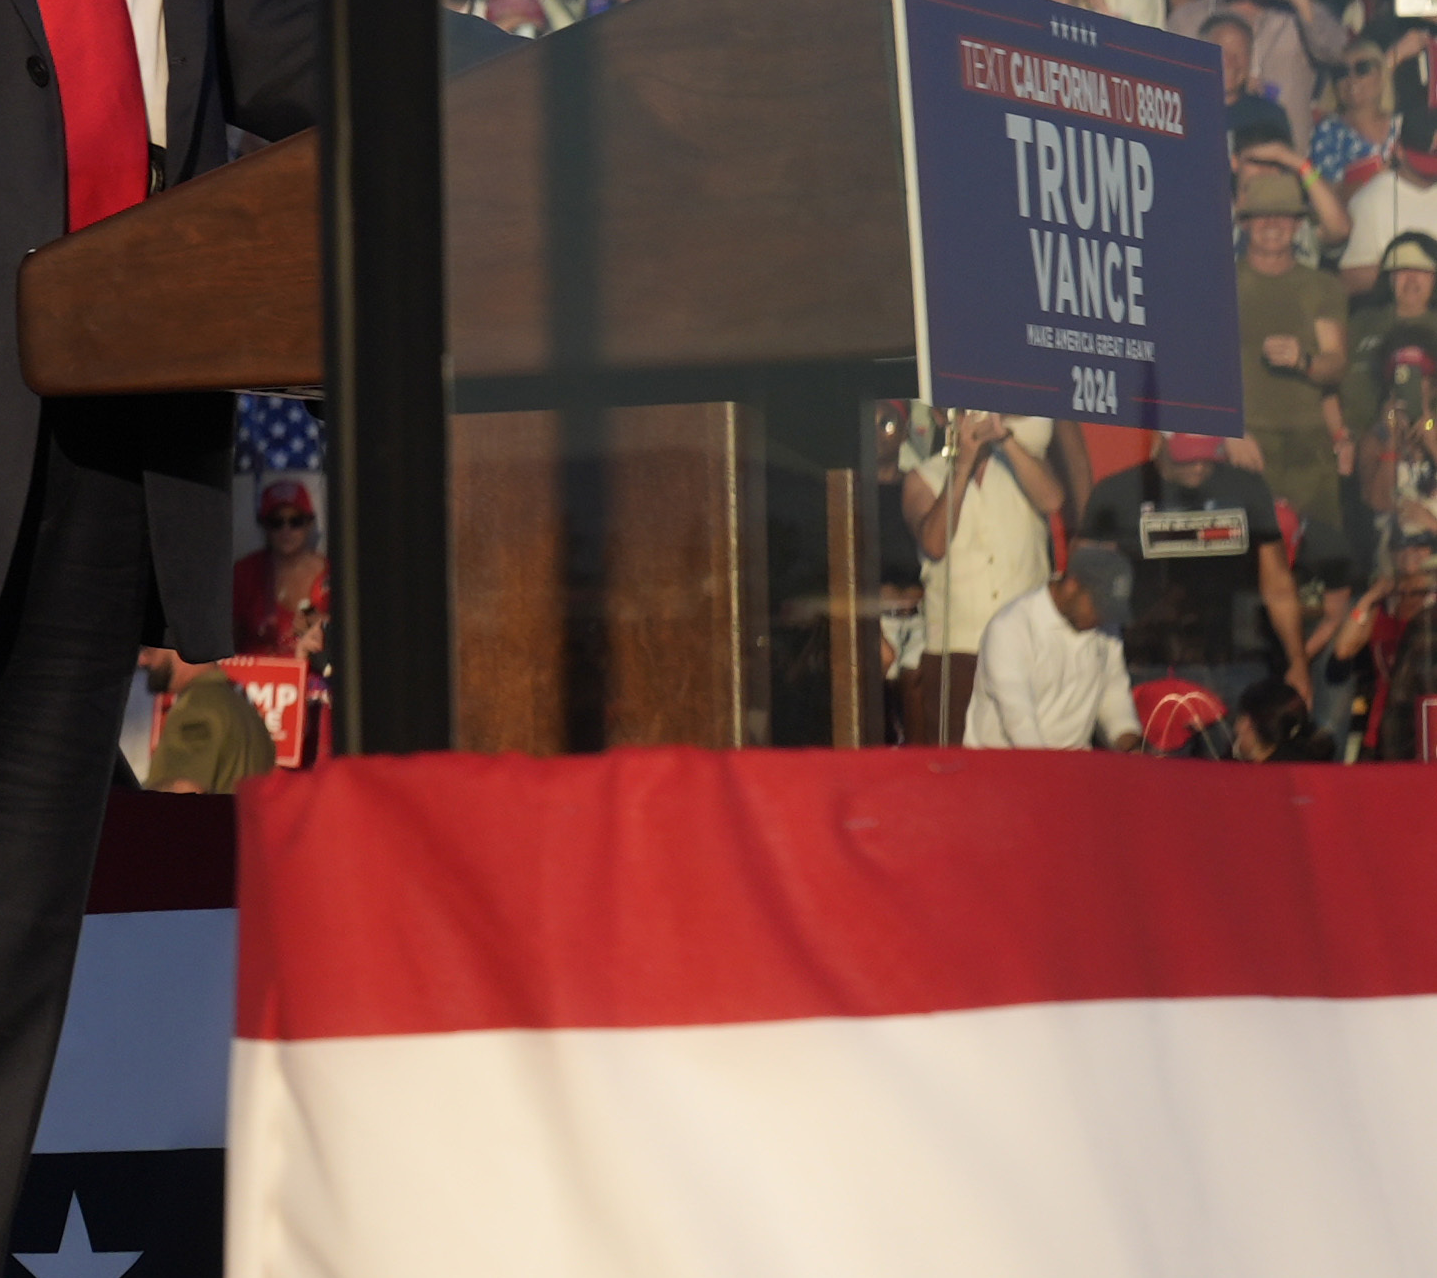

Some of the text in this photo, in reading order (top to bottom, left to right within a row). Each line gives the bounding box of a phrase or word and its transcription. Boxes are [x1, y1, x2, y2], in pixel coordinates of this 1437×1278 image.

[960, 39, 1184, 135] TEXT CALIFORNIA TO 88022
[1005, 112, 1154, 240] TRUMP
[1029, 227, 1146, 326] VANCE
[1026, 323, 1055, 349] MAKE
[1055, 326, 1096, 355] AMERICA
[1095, 333, 1124, 358] GREAT
[1071, 365, 1118, 415] 2024
